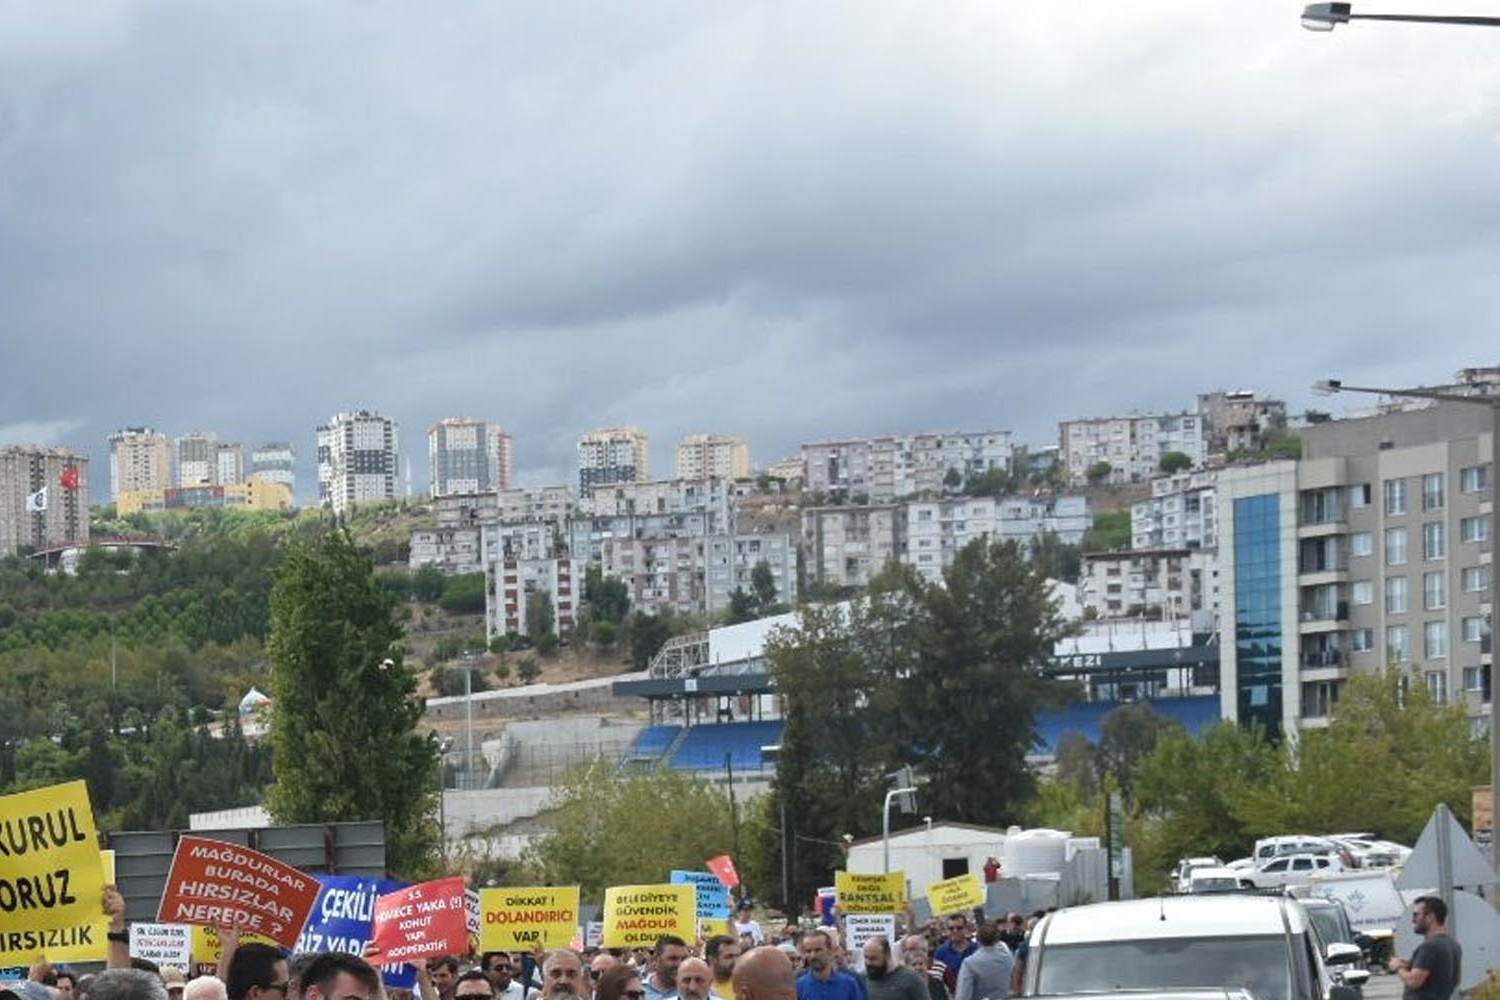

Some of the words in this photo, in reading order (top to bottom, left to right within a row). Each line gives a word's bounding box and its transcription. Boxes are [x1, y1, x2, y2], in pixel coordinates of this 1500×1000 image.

[190, 846, 306, 891] MAĞDURLAR
[205, 866, 279, 896] BURADA
[179, 880, 294, 922] HIRSIZLAR
[321, 883, 377, 923] ÇEKİLİ
[506, 896, 547, 906] DİKKAT
[616, 892, 678, 904] BELEDİYEYE
[416, 901, 447, 914] YAKA
[176, 903, 264, 929] NEREDE
[272, 923, 283, 937] ?
[399, 916, 432, 930] KONUT
[486, 910, 573, 924] DOLANDIRICI
[616, 918, 677, 930] MAĞDUR
[405, 931, 426, 942] YAPI
